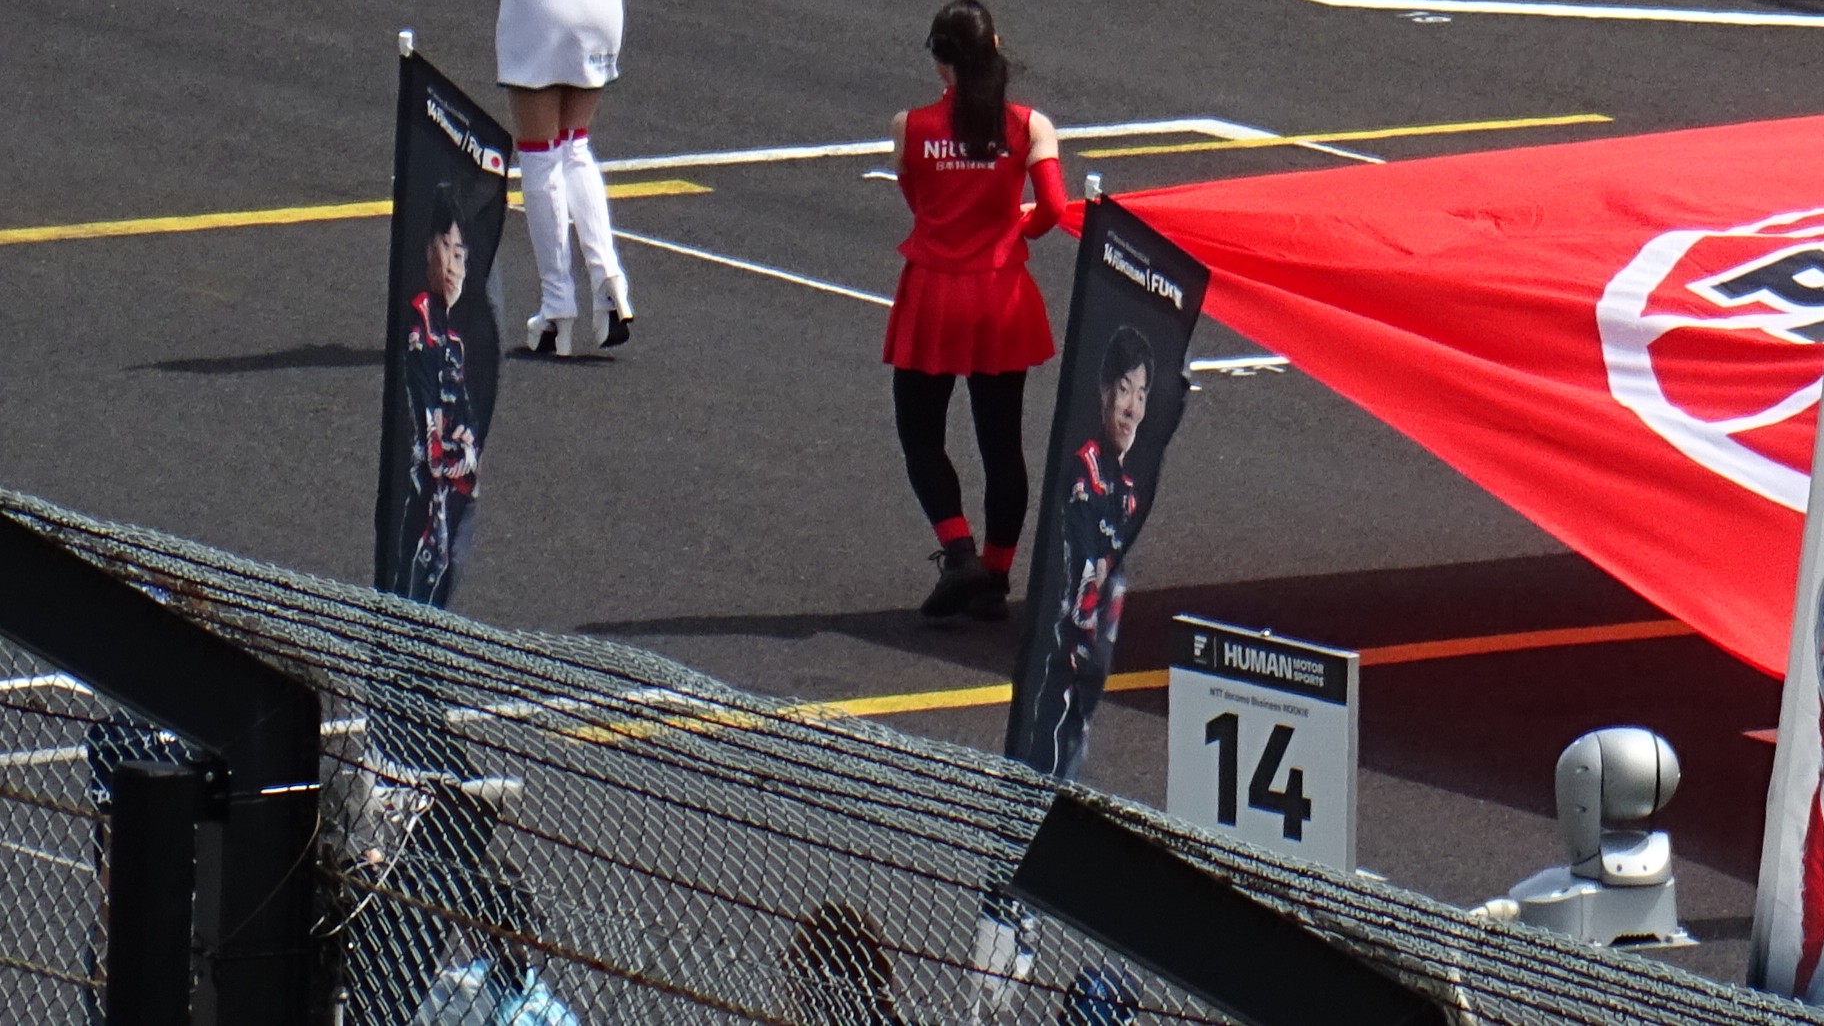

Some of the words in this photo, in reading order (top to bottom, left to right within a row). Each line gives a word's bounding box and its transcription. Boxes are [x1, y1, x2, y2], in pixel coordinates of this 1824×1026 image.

[1223, 641, 1293, 680] HUMAN
[1293, 658, 1324, 675] MOTOR
[1293, 672, 1325, 688] SPORTS
[1204, 712, 1312, 842] 14
